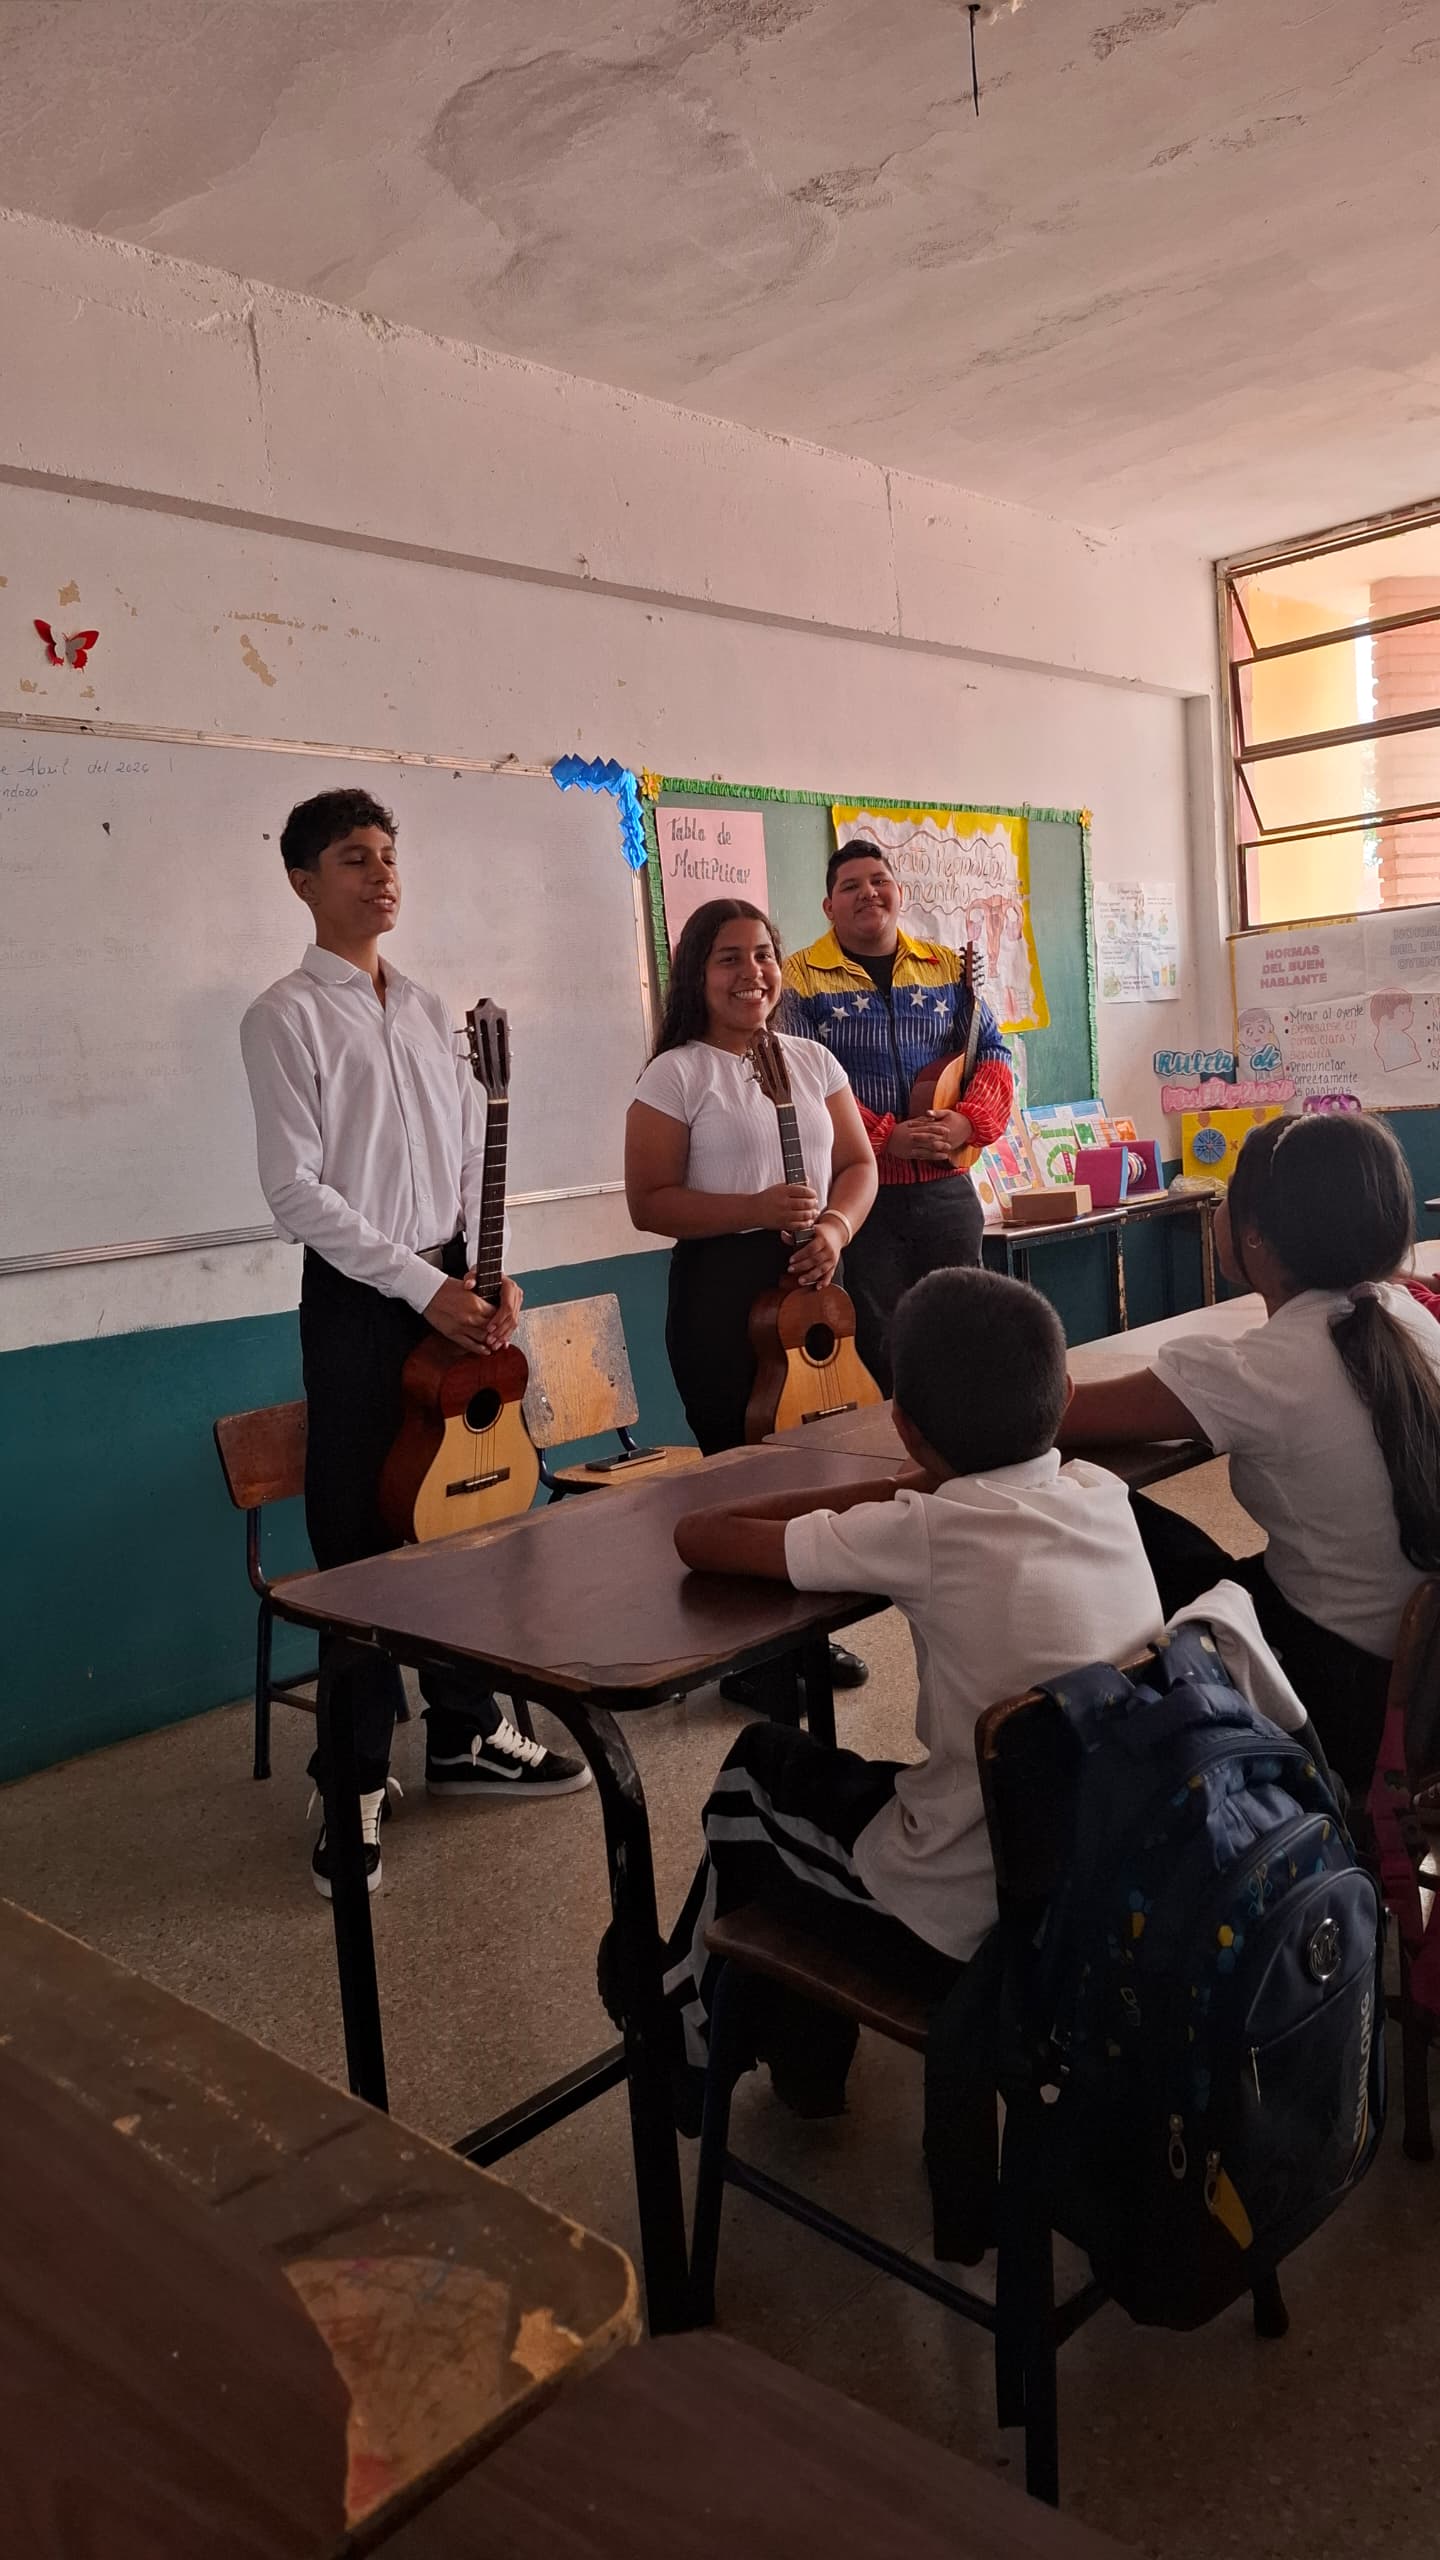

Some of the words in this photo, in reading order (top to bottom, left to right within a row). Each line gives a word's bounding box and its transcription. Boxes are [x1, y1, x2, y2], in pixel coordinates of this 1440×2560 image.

[87, 760, 109, 774] del
[667, 816, 705, 842] Tabla
[717, 821, 732, 846] de
[1265, 945, 1320, 961] NORMAS
[1262, 961, 1285, 975] DEL
[1288, 958, 1325, 972] BUEN
[1260, 973, 1328, 989] HABLANTE
[1322, 1008, 1332, 1020] al
[1156, 1050, 1233, 1075] Ruleta
[1252, 1044, 1281, 1070] de
